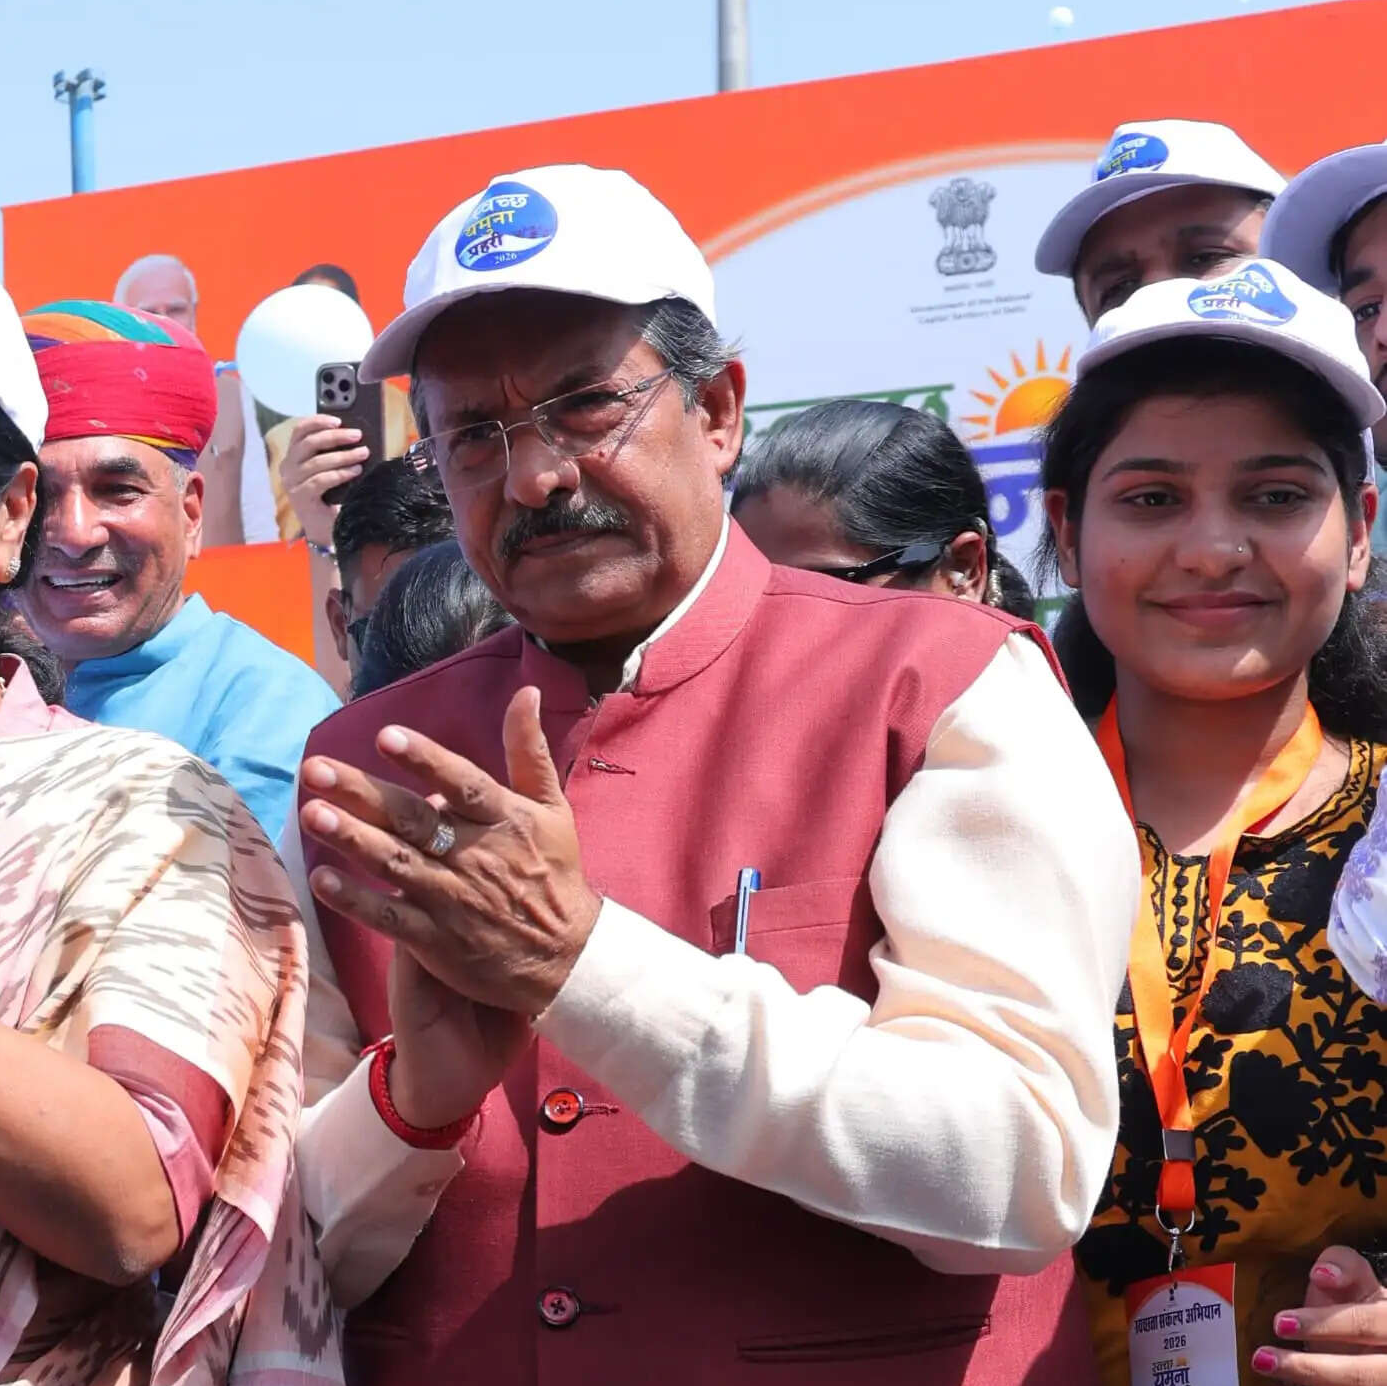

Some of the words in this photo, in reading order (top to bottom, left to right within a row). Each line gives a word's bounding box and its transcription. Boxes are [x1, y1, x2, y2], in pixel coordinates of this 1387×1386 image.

[475, 193, 530, 219] वच्छ
[1185, 1302, 1221, 1324] अभियान
[1163, 1335, 1187, 1350] 2026
